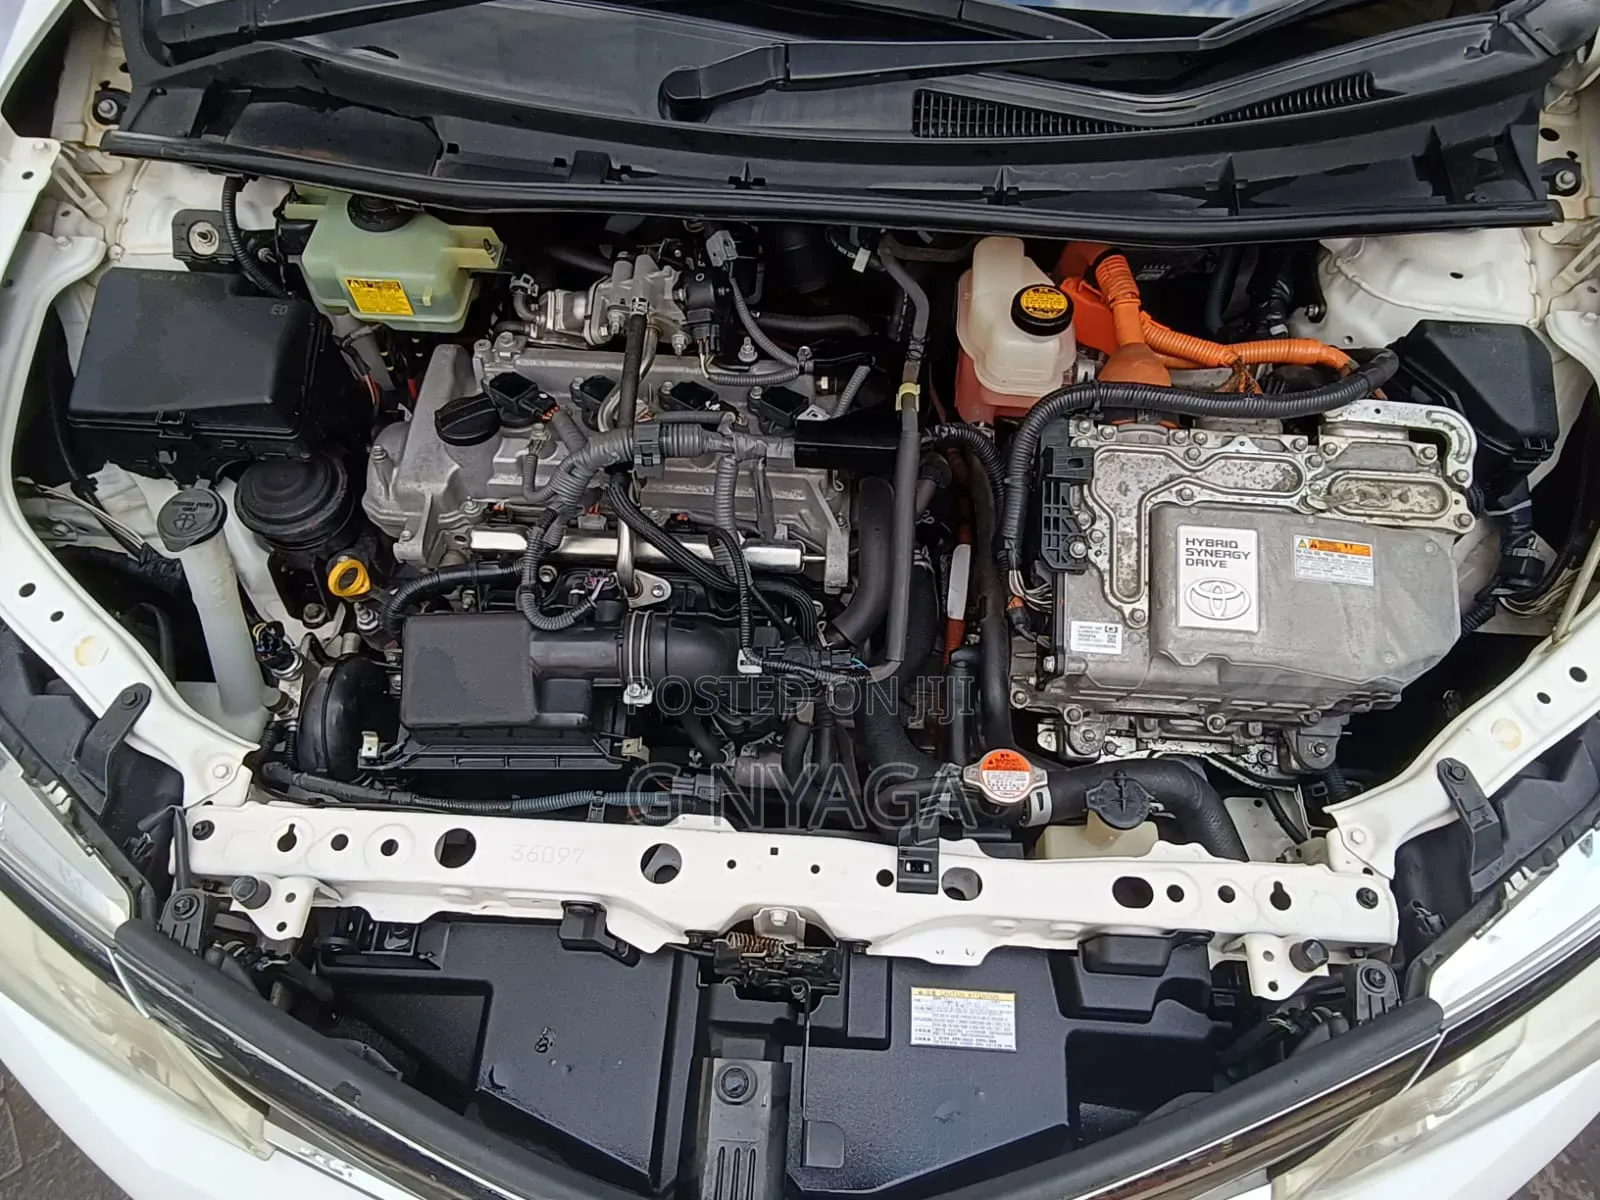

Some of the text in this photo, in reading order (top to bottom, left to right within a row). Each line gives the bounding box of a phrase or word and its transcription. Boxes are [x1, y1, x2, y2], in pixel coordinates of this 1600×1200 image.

[1185, 538, 1239, 549] HYBRID
[1185, 548, 1251, 560] SYNERGY
[1185, 558, 1228, 569] DRIVE
[510, 843, 585, 865] 36097
